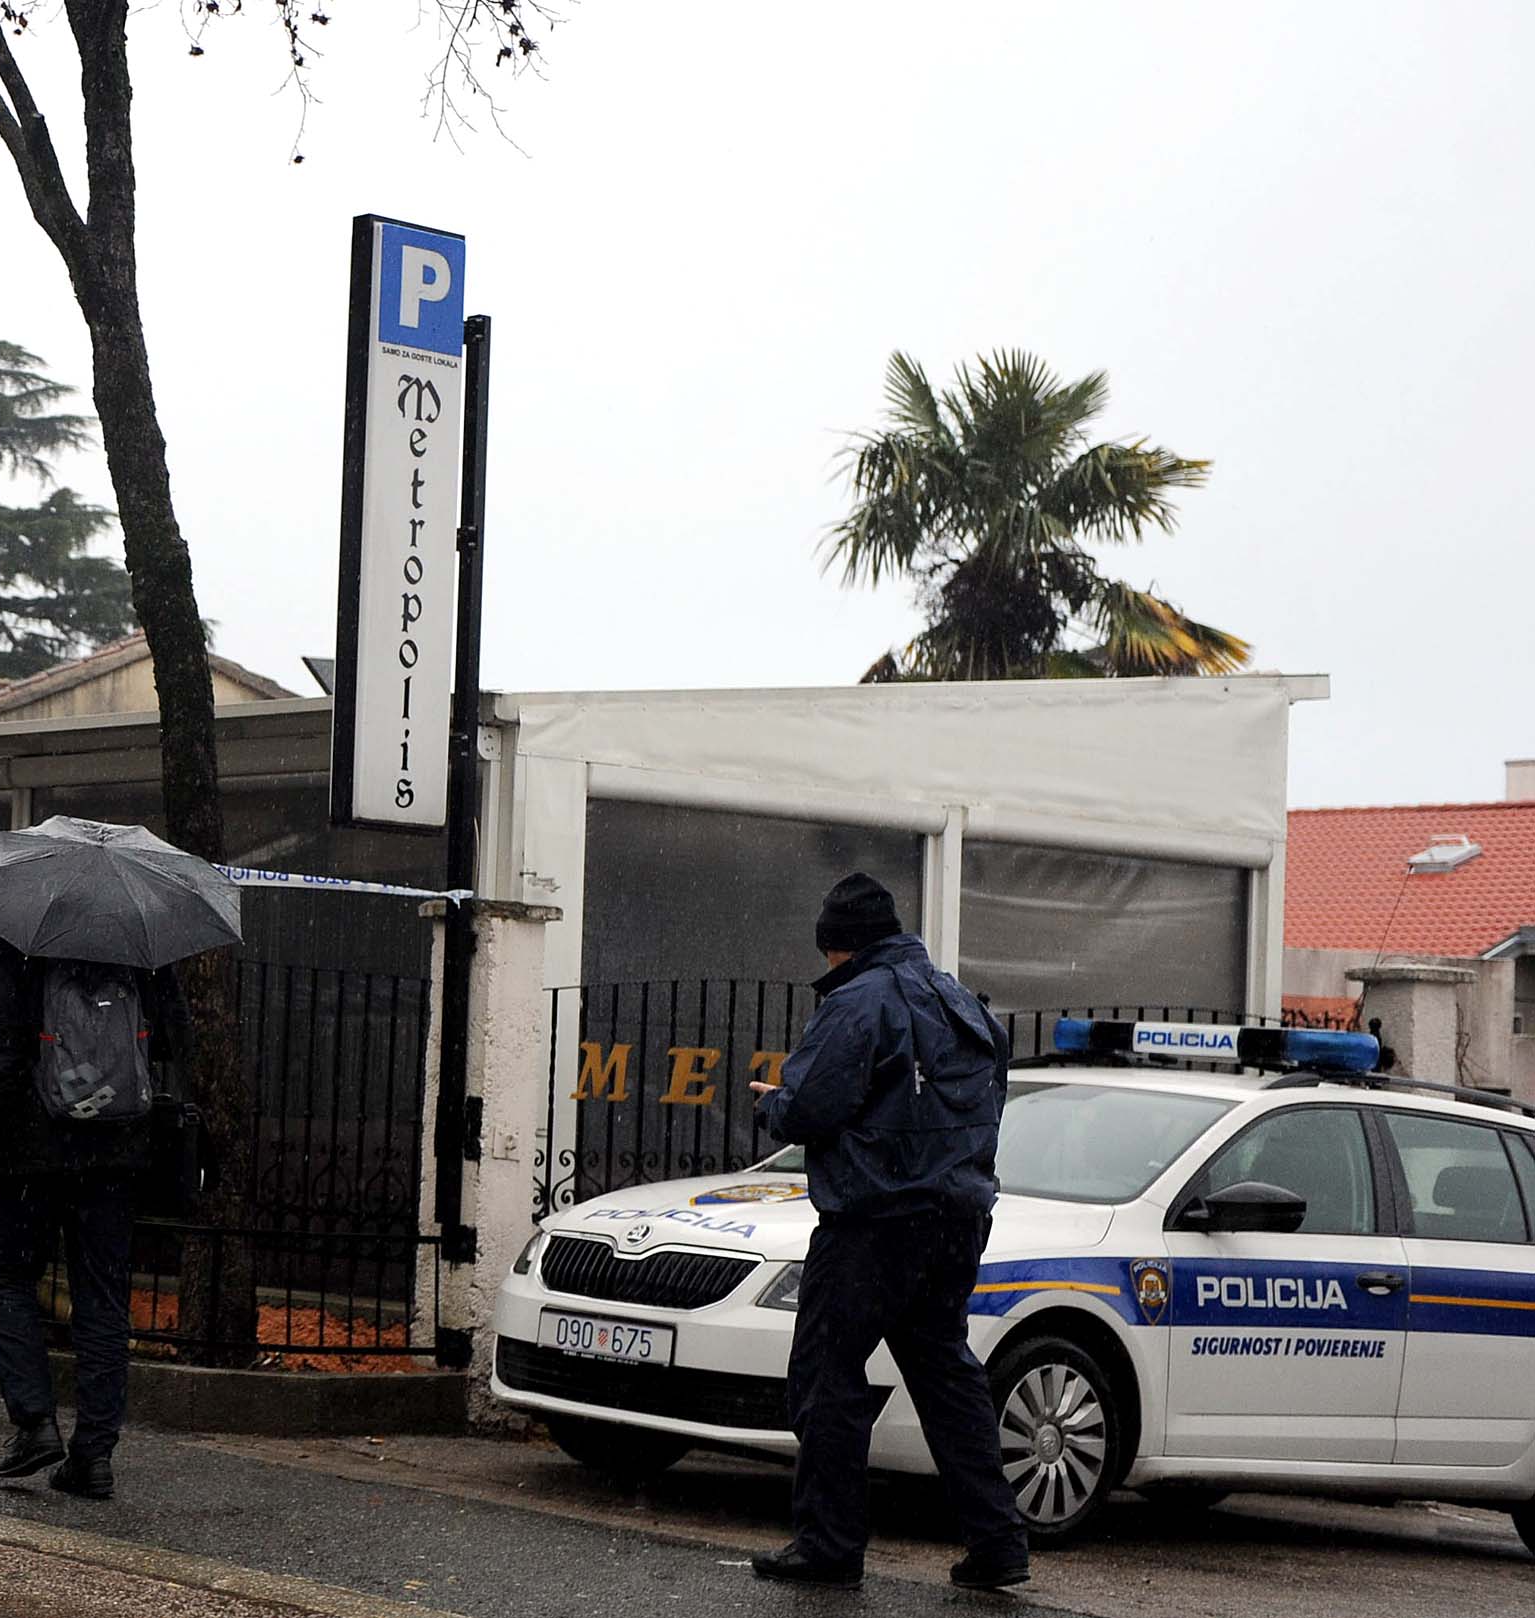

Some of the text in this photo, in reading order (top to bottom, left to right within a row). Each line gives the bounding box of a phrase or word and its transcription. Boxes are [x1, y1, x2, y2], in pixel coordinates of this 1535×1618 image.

[399, 245, 451, 328] P
[381, 346, 458, 369] SAMO ZA GOSTE LOKALA
[394, 373, 441, 808] Metropolis
[1137, 1030, 1234, 1049] POLICIJA
[584, 1208, 757, 1239] POLICIJA
[1196, 1276, 1348, 1310] POLICIJA
[556, 1318, 594, 1349] 090
[611, 1325, 653, 1358] 675
[1191, 1337, 1386, 1359] SIGURNOST I POVJERENJE
